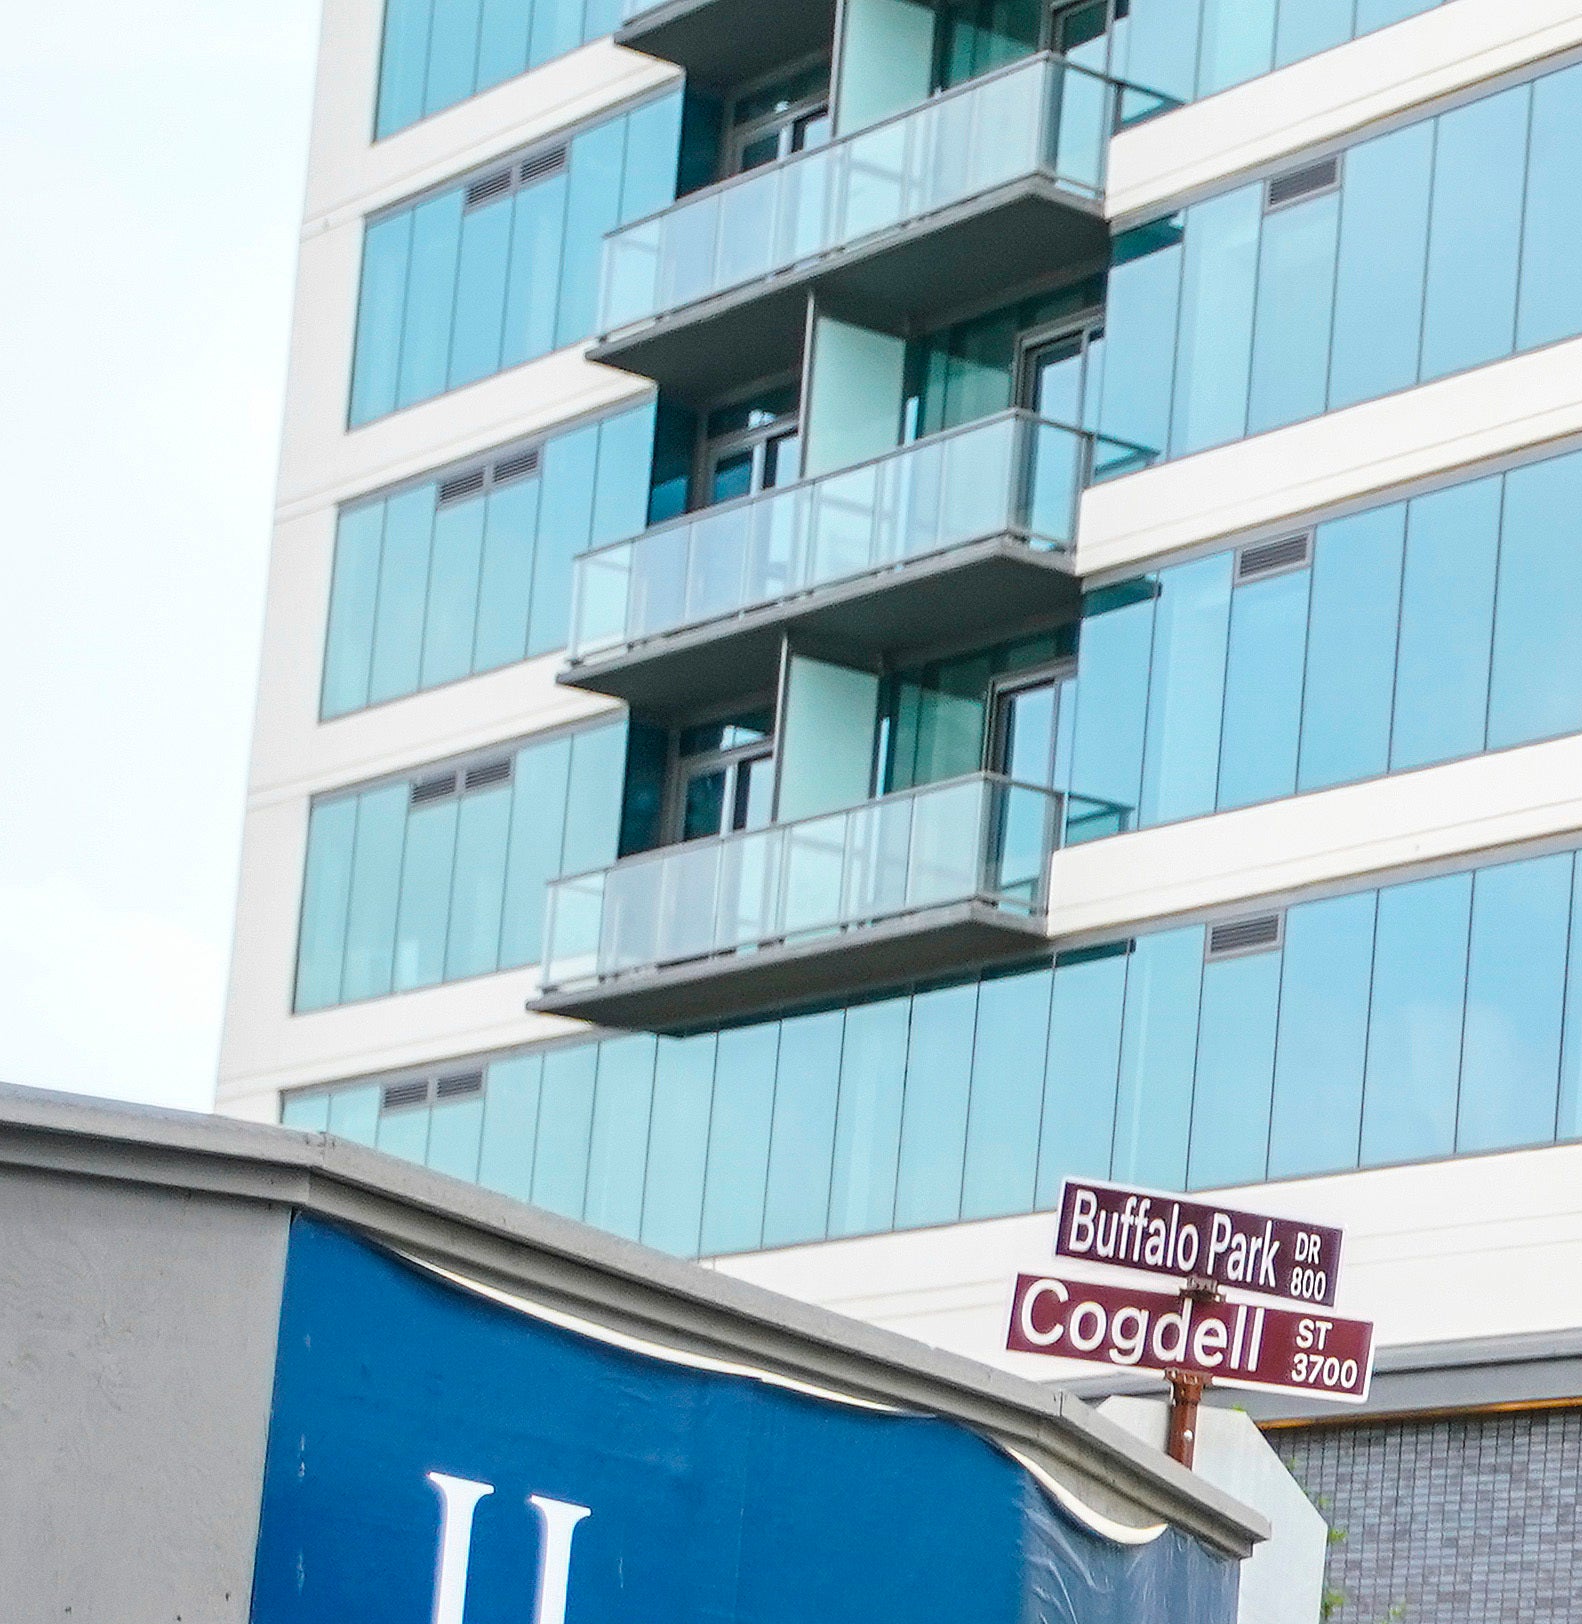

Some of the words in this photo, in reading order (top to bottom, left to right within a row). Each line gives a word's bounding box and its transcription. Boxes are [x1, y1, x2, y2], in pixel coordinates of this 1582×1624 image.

[1068, 1189, 1198, 1272] Buffalo
[1206, 1212, 1281, 1289] Park
[1294, 1231, 1321, 1265] DR
[1289, 1267, 1327, 1302] 800
[1020, 1278, 1265, 1373] Cogdell
[1295, 1318, 1333, 1351] ST
[1290, 1353, 1359, 1390] 3700
